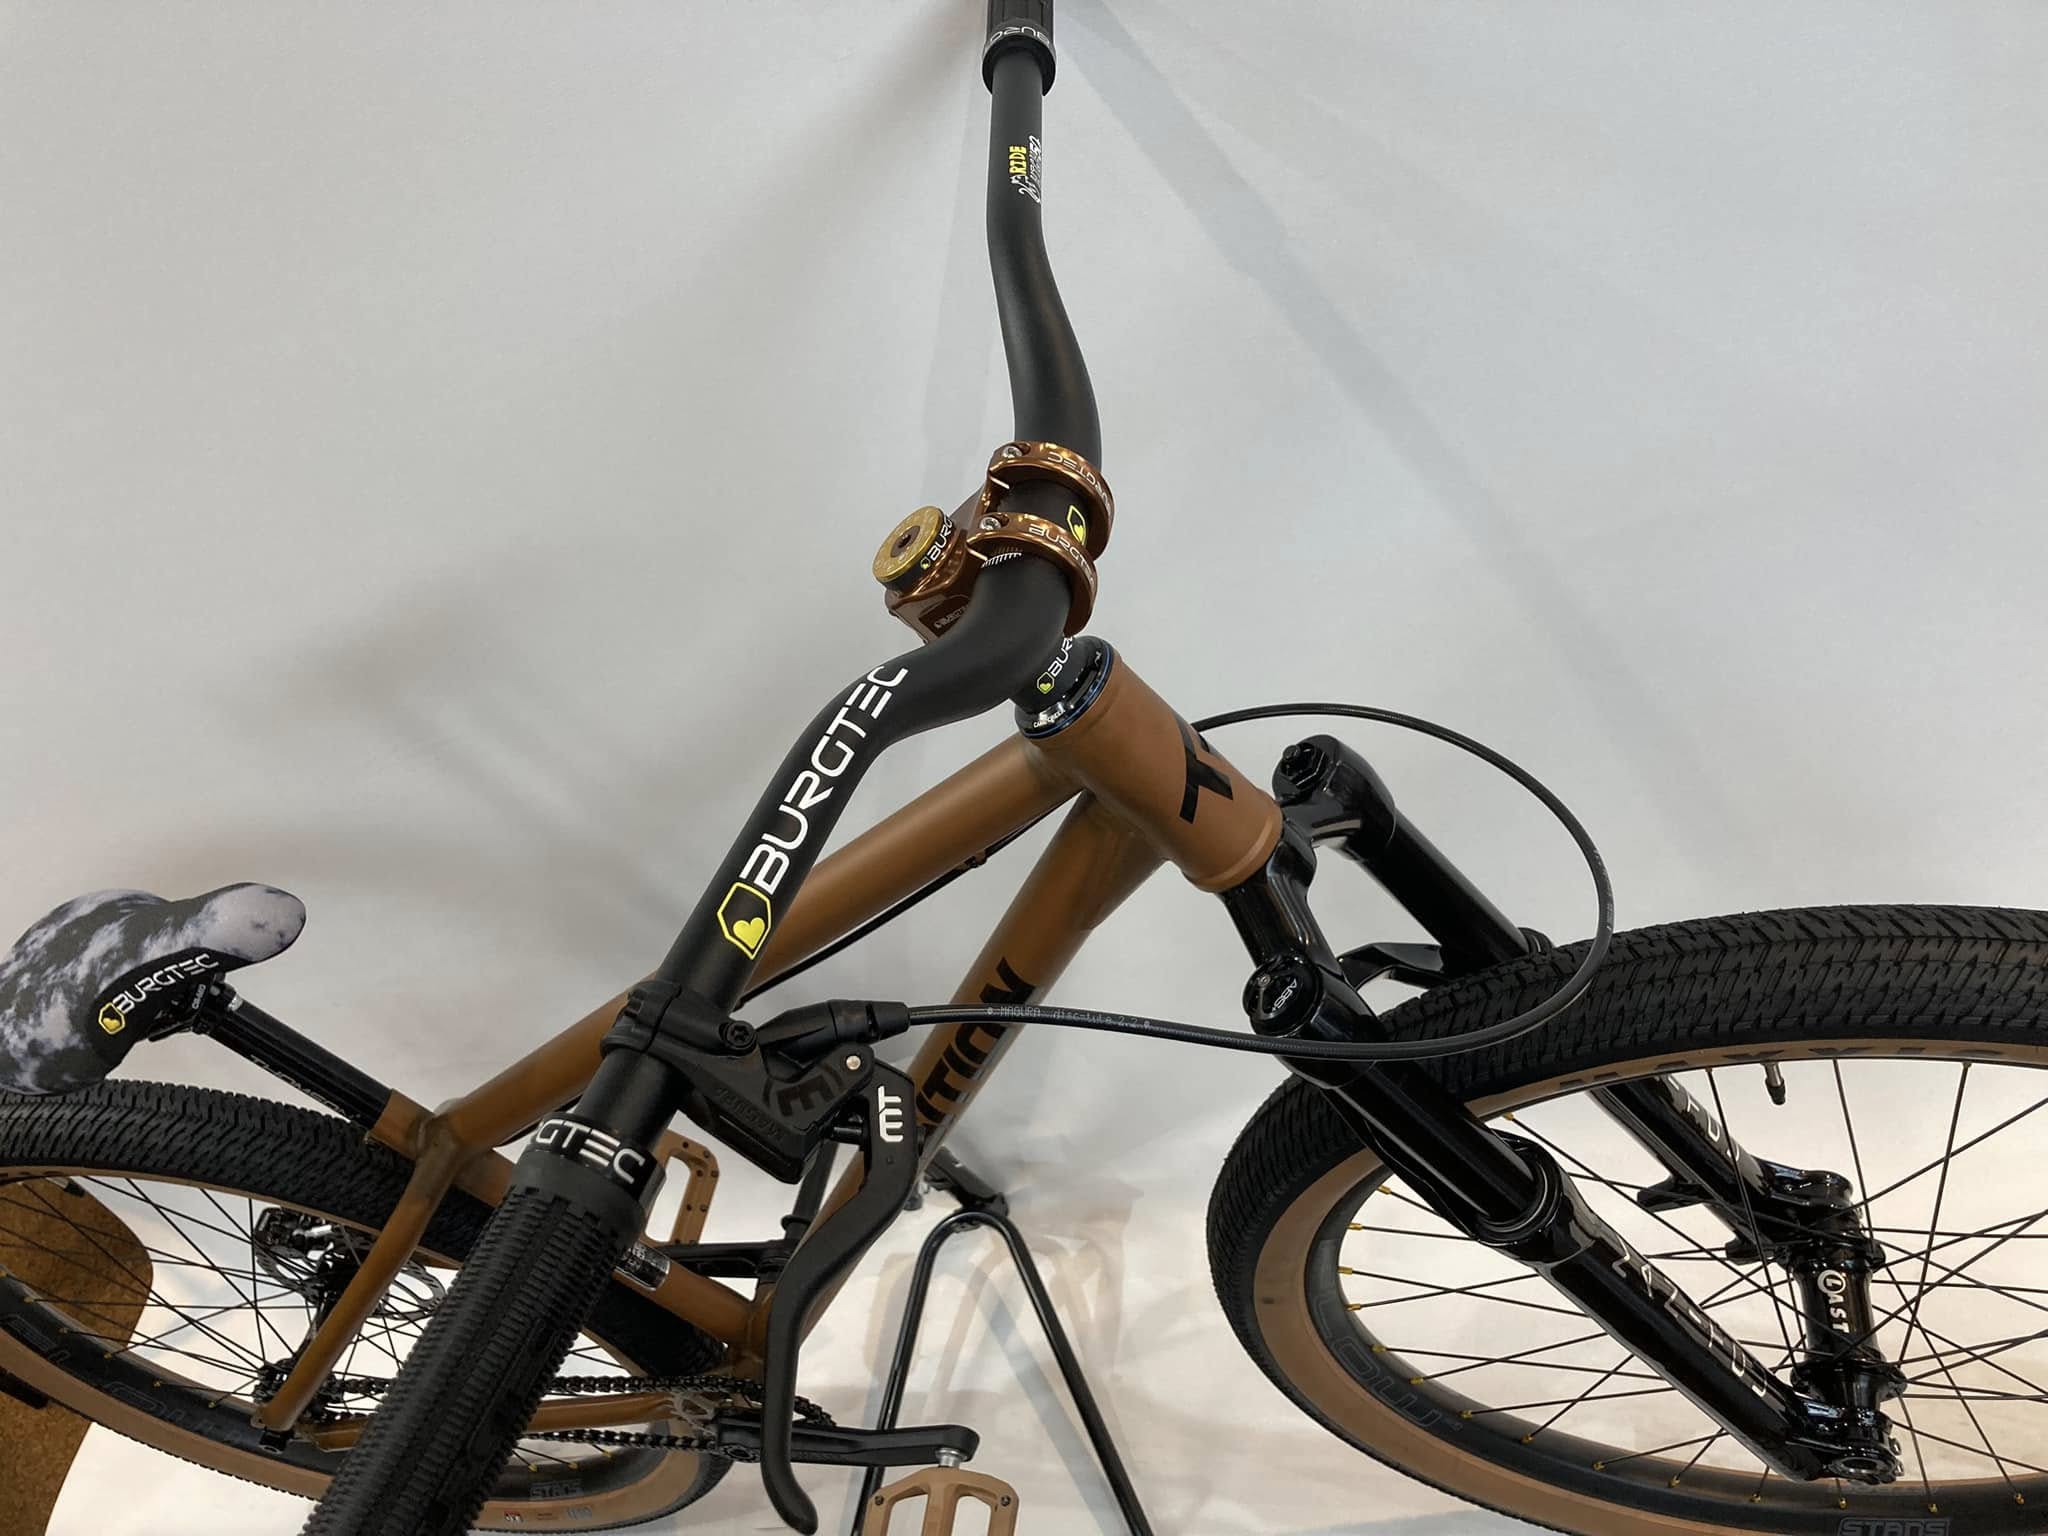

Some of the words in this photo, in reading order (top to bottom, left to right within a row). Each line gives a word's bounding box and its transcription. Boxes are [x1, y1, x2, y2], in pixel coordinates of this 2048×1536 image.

[1009, 145, 1027, 176] RIDE
[1047, 637, 1073, 678] BUR
[738, 665, 909, 895] BURGTEC
[113, 953, 219, 1015] BURGTEC
[1000, 1005, 1042, 1018] MAGURA
[535, 1118, 646, 1185] GTEC
